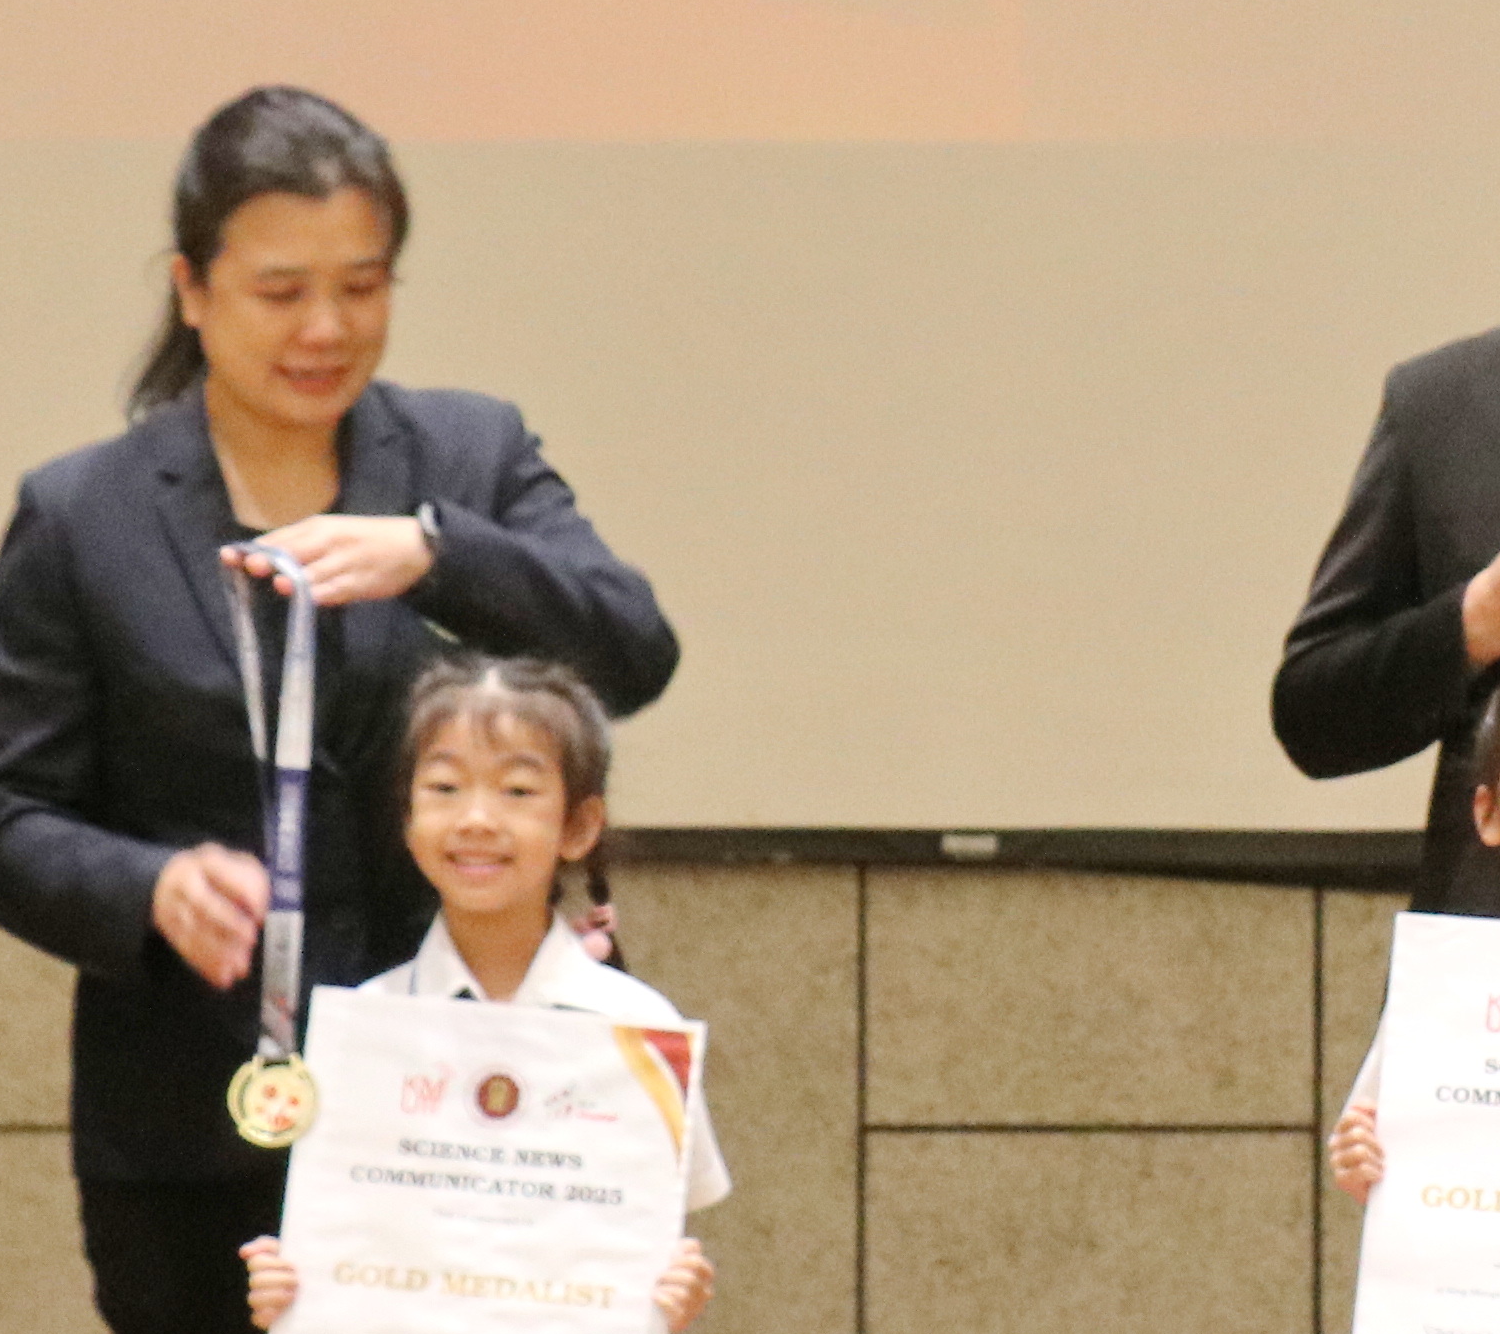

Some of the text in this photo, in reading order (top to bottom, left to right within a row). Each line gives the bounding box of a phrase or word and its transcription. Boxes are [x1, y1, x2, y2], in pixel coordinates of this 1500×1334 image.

[398, 1138, 583, 1170] SCIENCE NEWS
[350, 1165, 623, 1205] COMMUNICATOR 2025
[333, 1261, 614, 1309] GOLD MEDALIST
